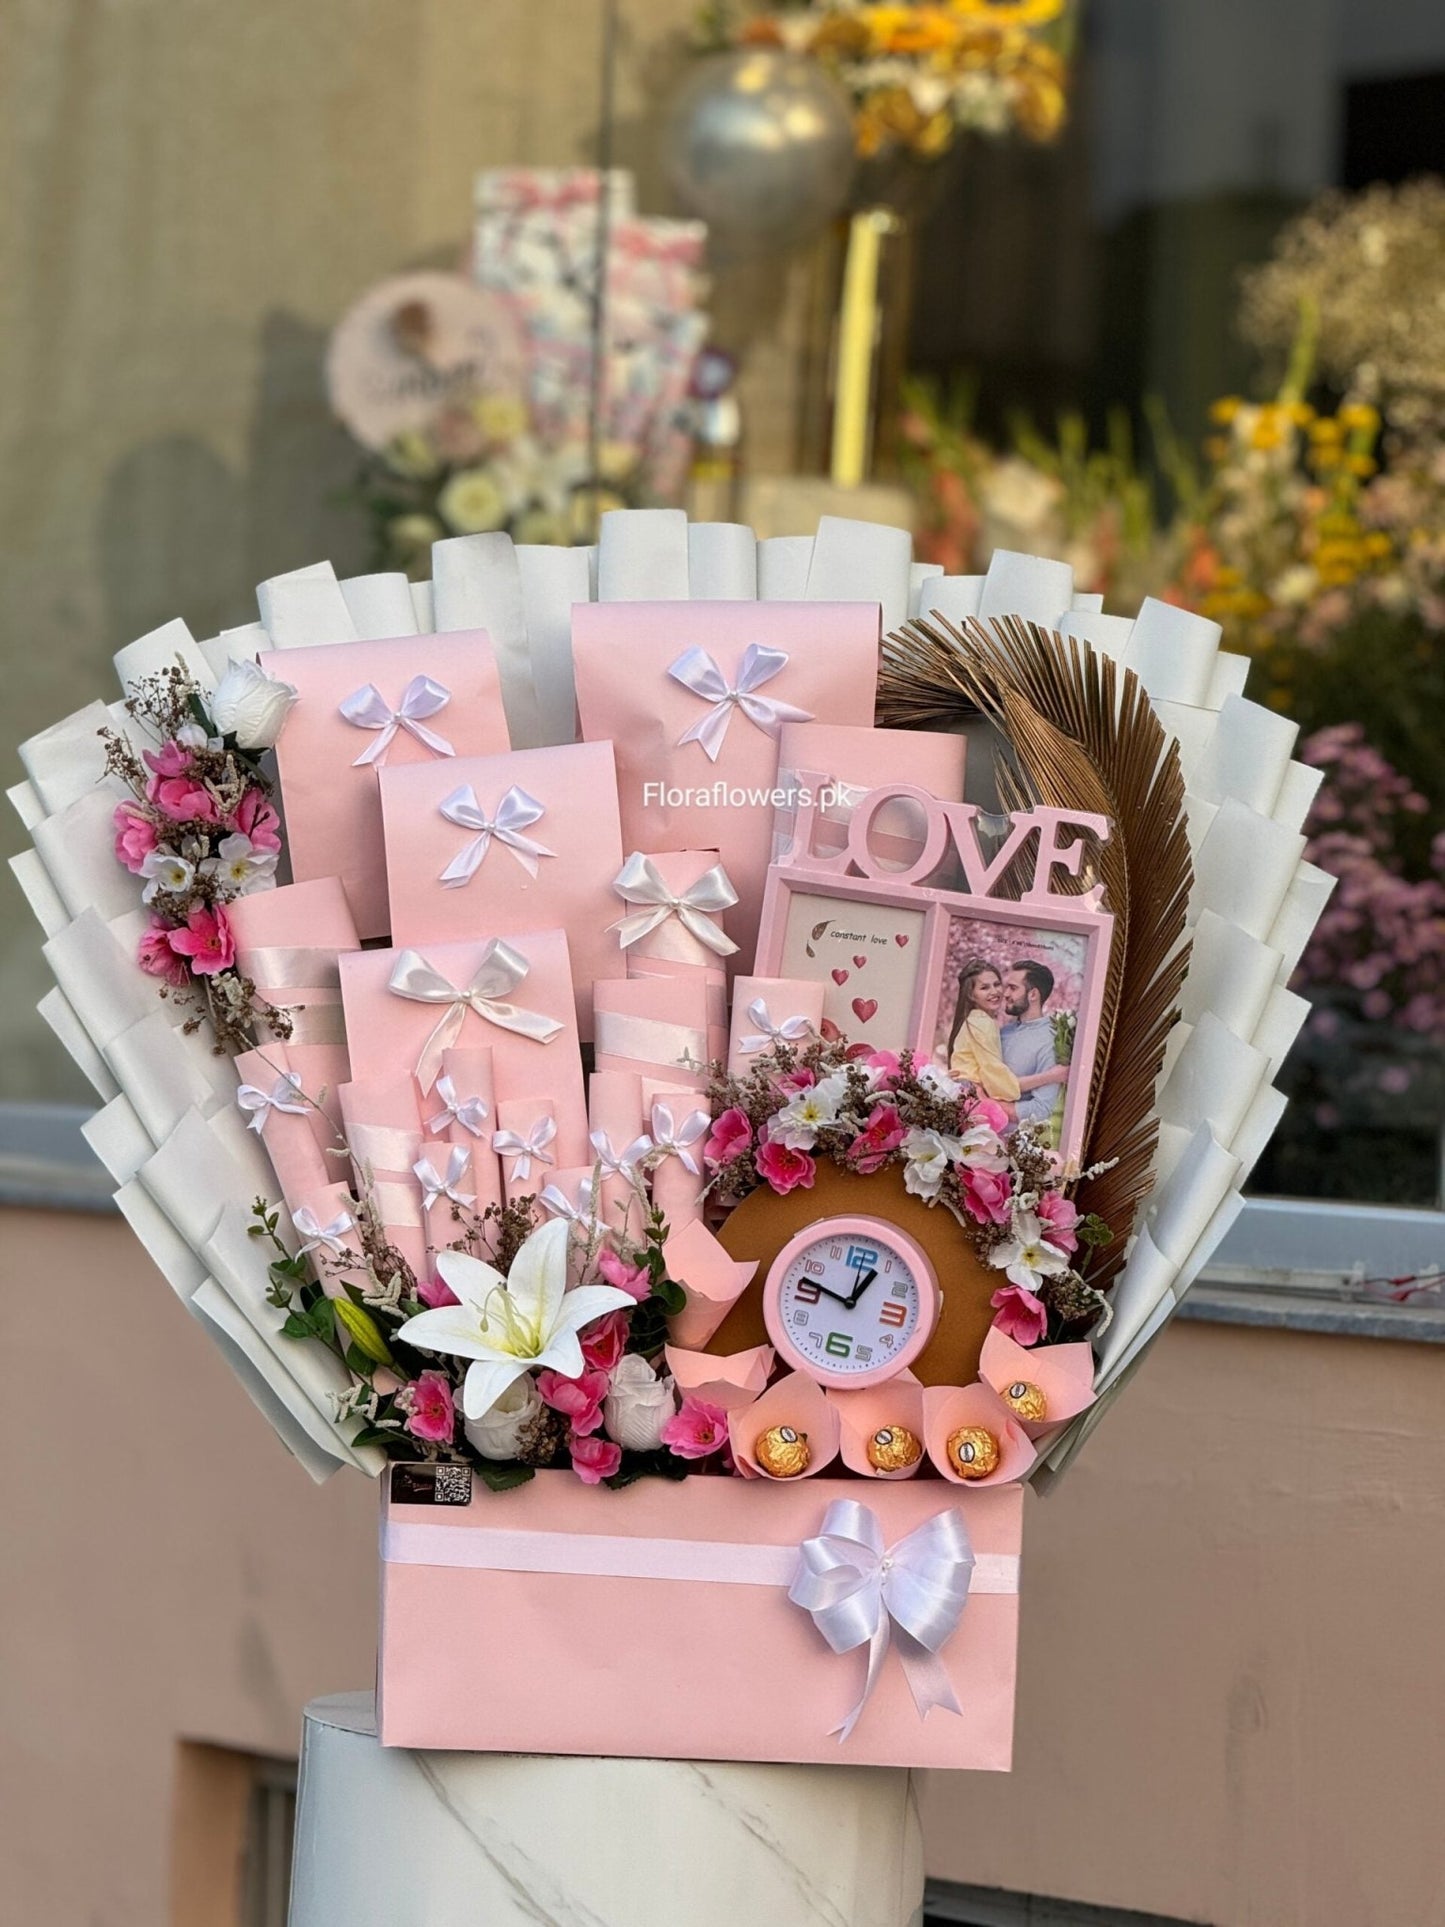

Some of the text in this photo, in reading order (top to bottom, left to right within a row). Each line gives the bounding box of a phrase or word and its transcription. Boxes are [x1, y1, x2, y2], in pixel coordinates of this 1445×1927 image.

[791, 769, 1112, 905] LOVE
[830, 931, 888, 945] constant love
[831, 1245, 842, 1260] 11
[846, 1245, 878, 1271] 12
[805, 1260, 825, 1275] 10
[885, 1260, 892, 1273] 1
[794, 1278, 821, 1304] 9
[892, 1282, 907, 1298] 2
[794, 1310, 808, 1326] 8
[879, 1302, 907, 1328] 3
[809, 1332, 823, 1348] 7
[825, 1332, 853, 1358] 6
[879, 1334, 893, 1348] 4
[855, 1345, 873, 1362] 5
